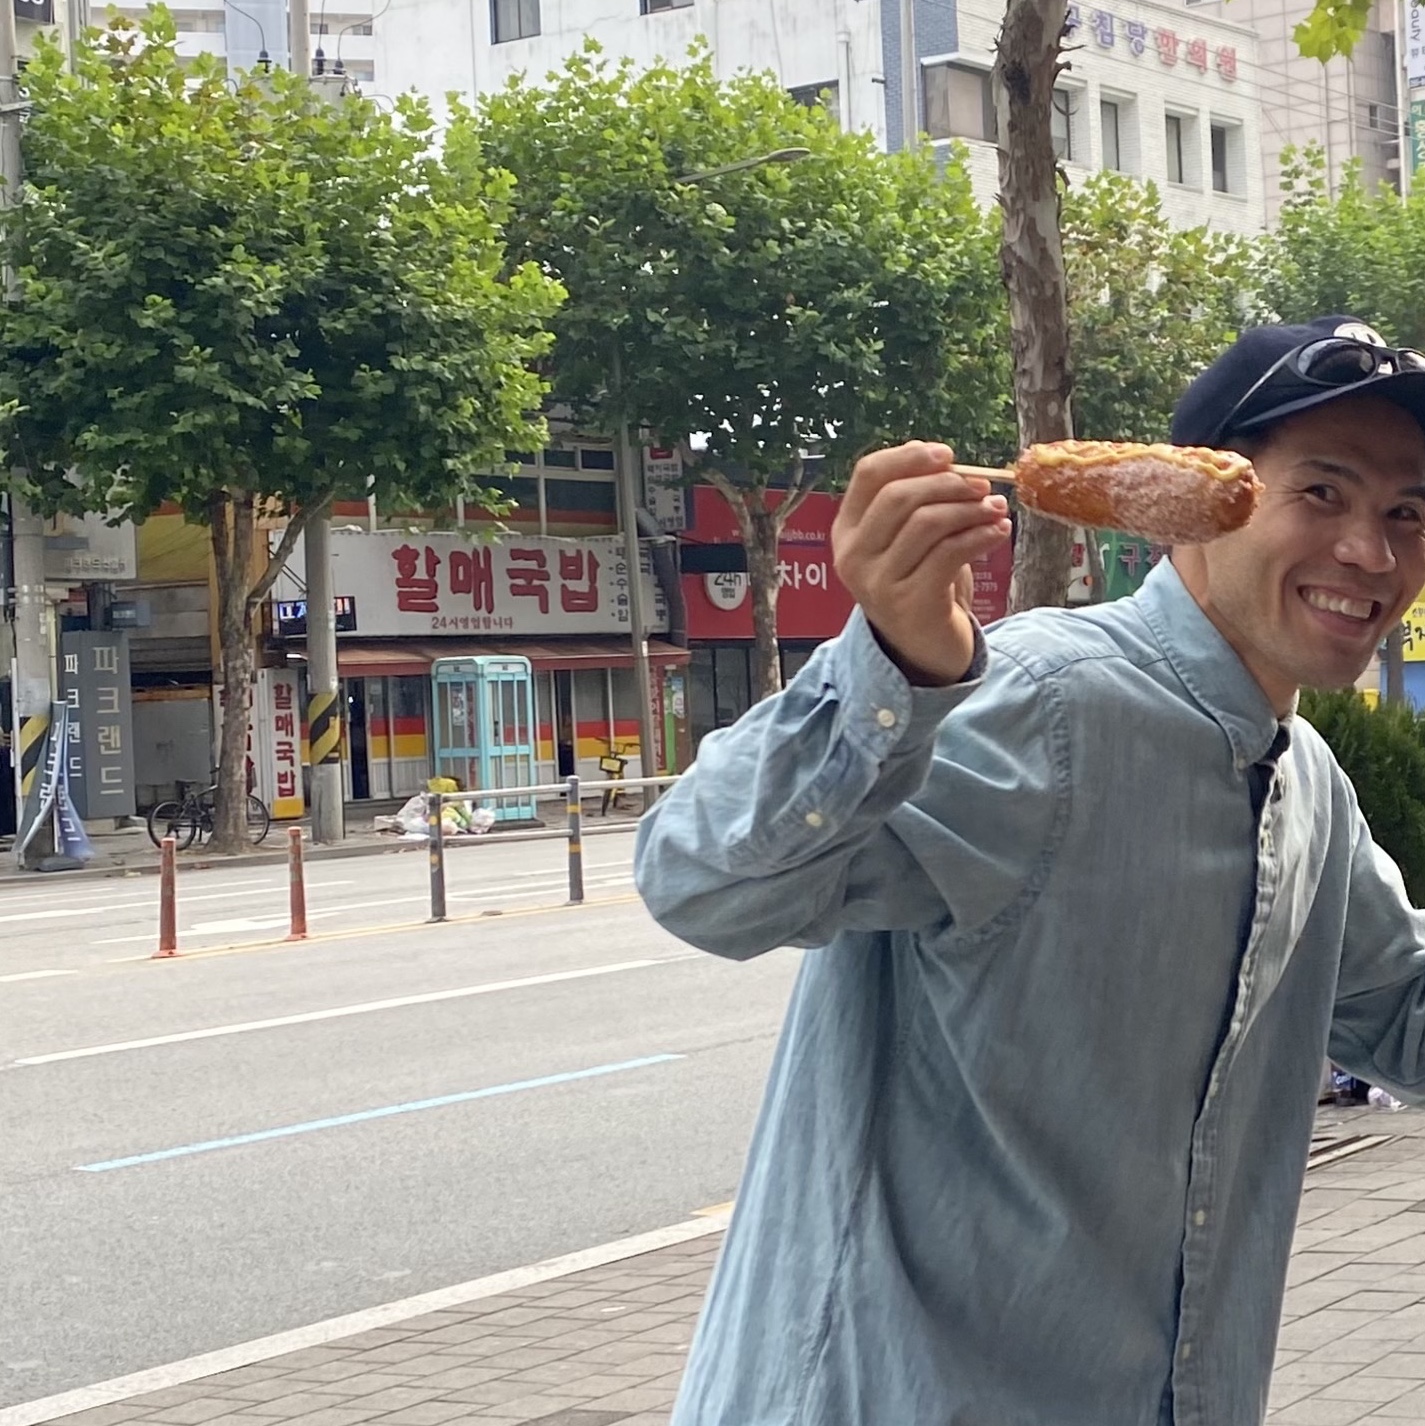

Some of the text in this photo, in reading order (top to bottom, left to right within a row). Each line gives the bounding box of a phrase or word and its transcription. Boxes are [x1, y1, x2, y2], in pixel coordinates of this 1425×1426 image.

[391, 544, 601, 614] 할매국밥
[93, 646, 125, 795] 파크랜드
[273, 683, 296, 798] 할매국밥
